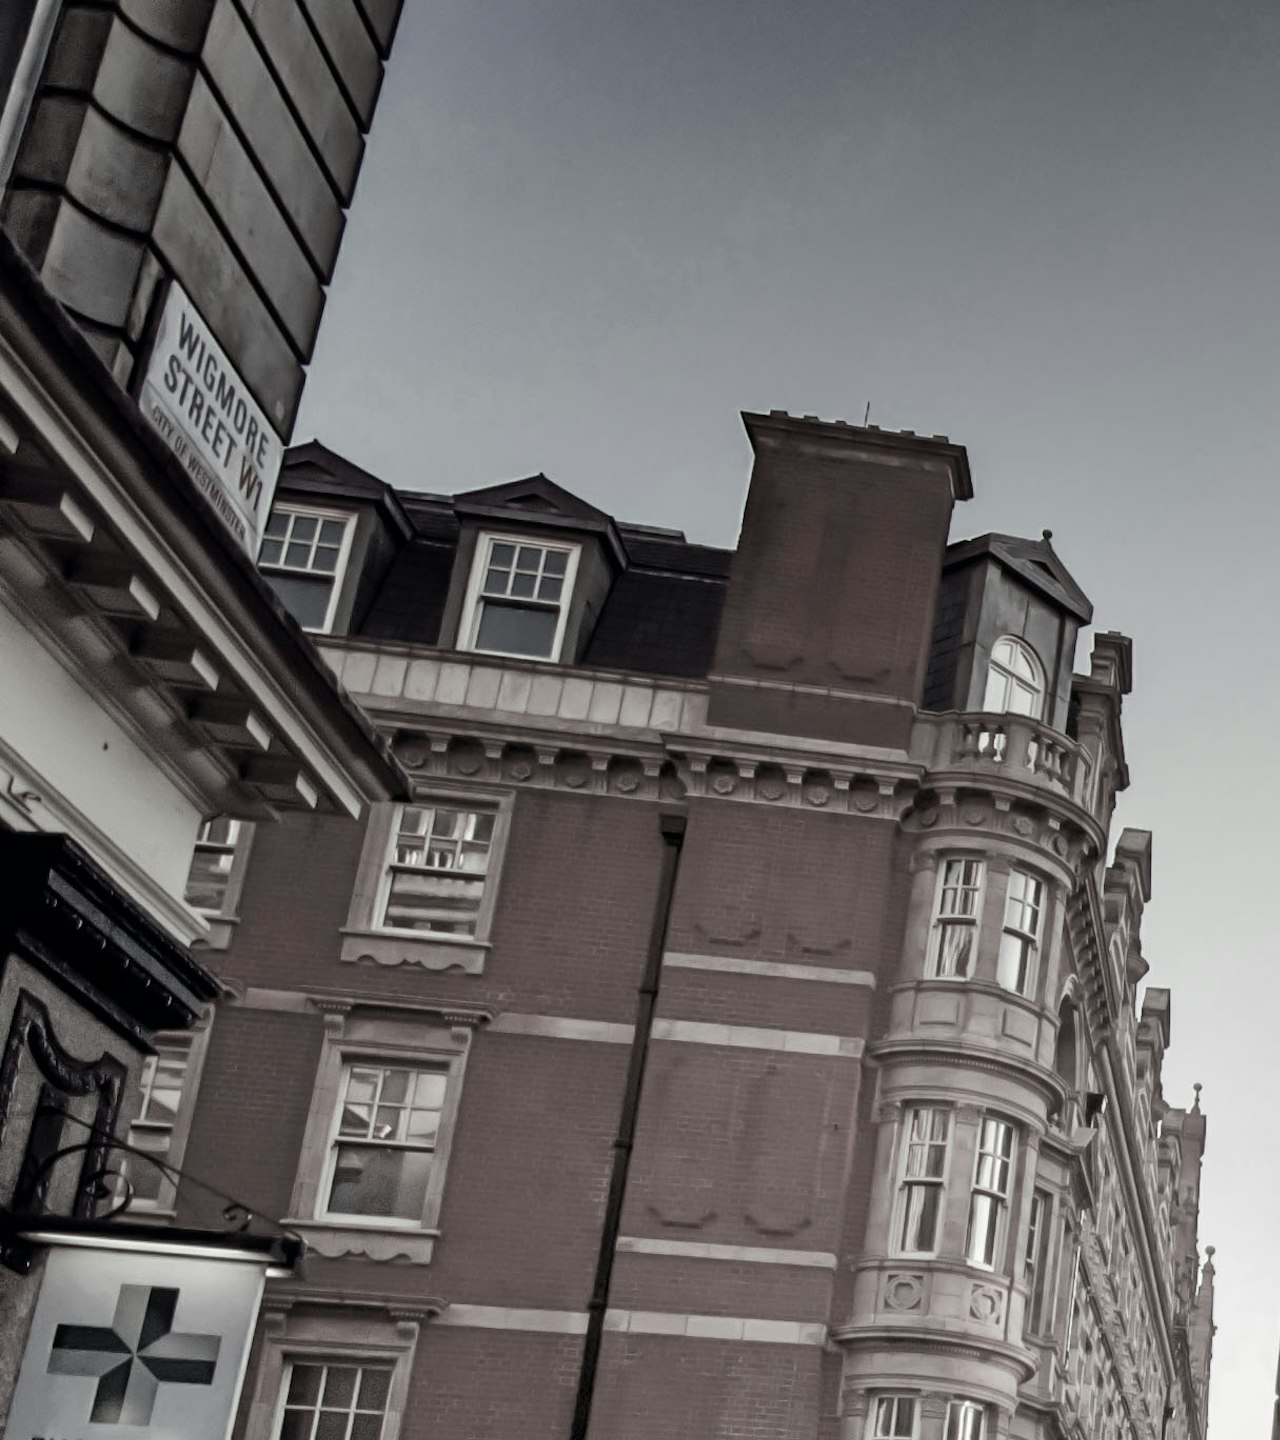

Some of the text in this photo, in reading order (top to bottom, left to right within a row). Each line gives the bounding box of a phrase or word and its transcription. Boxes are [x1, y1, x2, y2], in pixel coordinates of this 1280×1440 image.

[164, 353, 264, 512] STREET W1
[178, 310, 270, 471] WIGMORE
[151, 405, 247, 542] CITY OF WESTMINSTER
